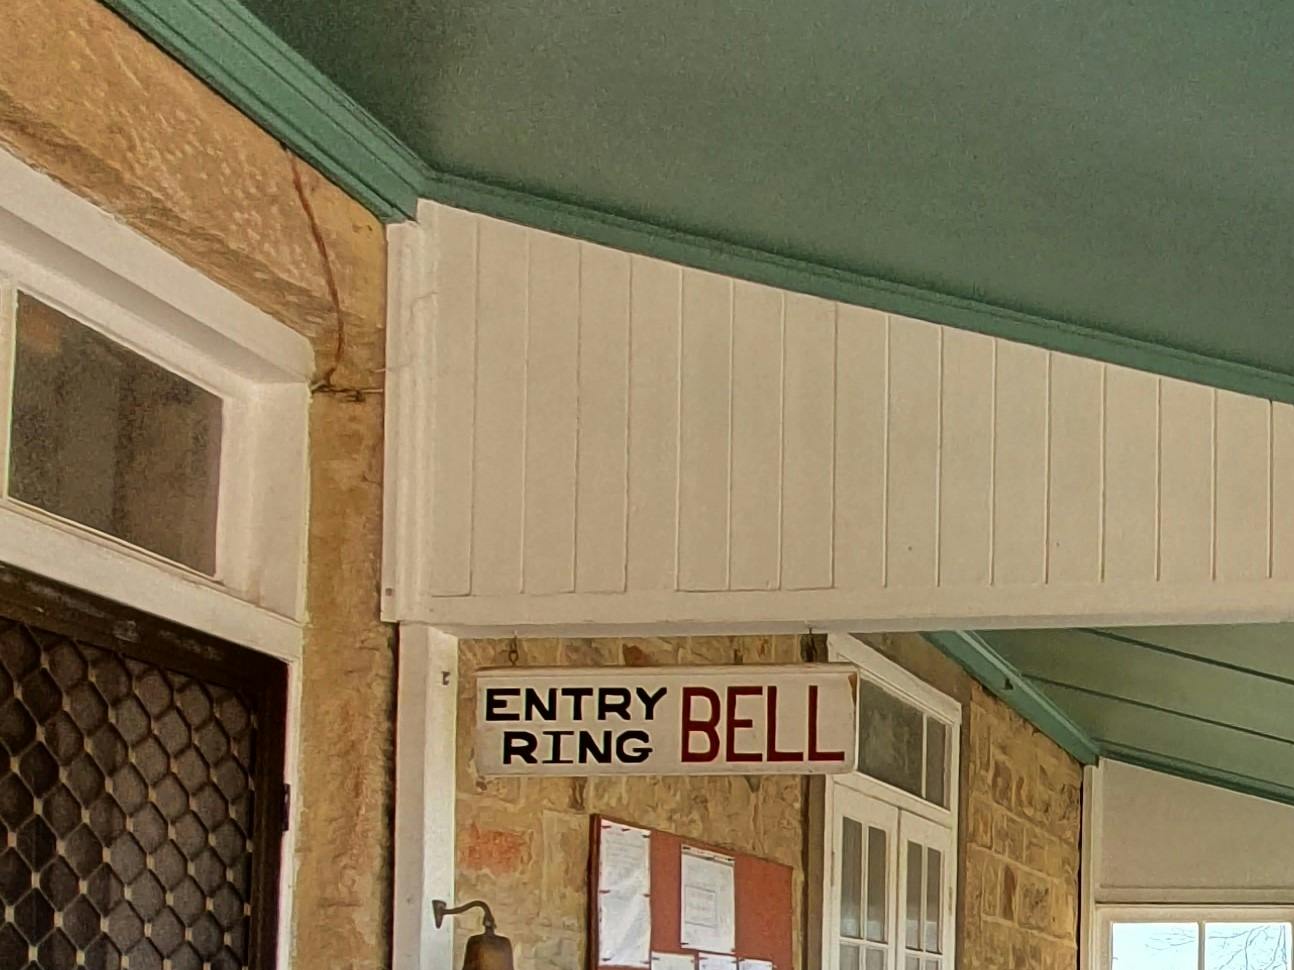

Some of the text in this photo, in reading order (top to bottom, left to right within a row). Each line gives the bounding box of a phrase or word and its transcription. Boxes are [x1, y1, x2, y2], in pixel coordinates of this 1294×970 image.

[485, 687, 667, 721] ENTRY
[680, 685, 845, 763] BELL
[503, 730, 653, 764] RING
